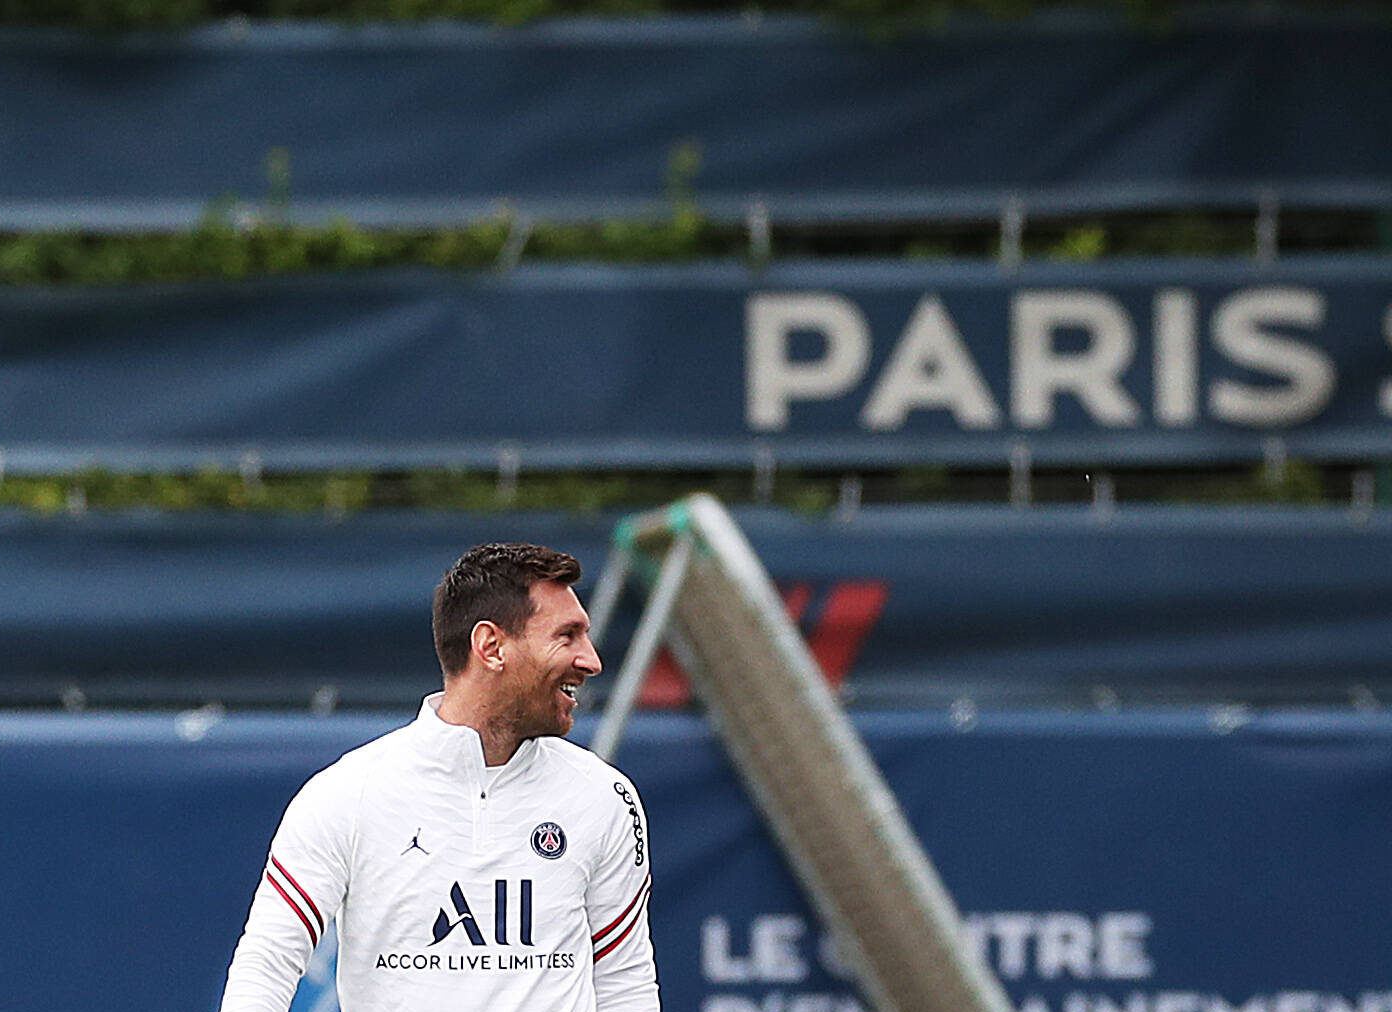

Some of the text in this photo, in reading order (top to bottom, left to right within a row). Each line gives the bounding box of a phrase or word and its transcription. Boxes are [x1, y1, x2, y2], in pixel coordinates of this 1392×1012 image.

[744, 287, 1337, 431] PARIS
[376, 953, 575, 970] ACCOR LIVE LIMITLESS
[701, 914, 808, 984] LE
